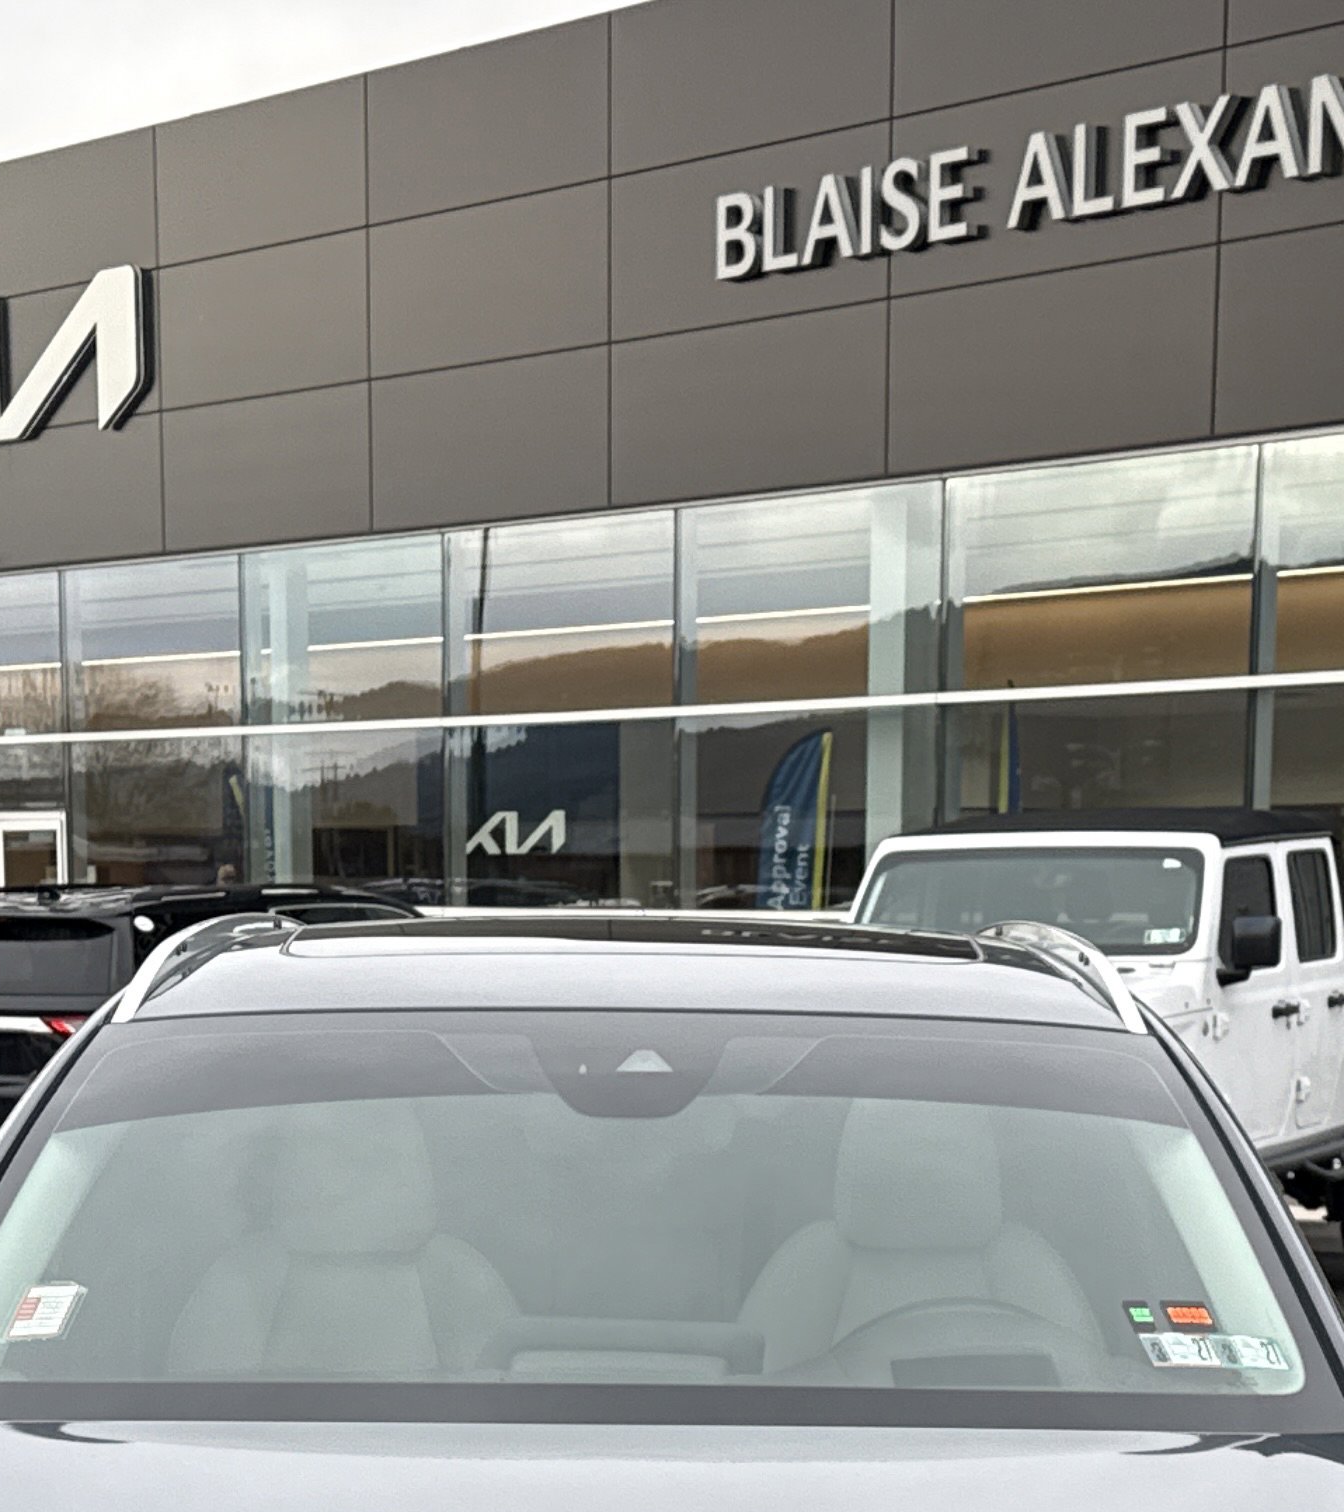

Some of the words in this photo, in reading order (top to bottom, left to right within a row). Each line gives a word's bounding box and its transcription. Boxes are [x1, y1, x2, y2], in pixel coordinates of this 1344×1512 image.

[715, 146, 976, 281] BLAISE
[761, 805, 791, 911] Approval
[789, 843, 810, 905] Event
